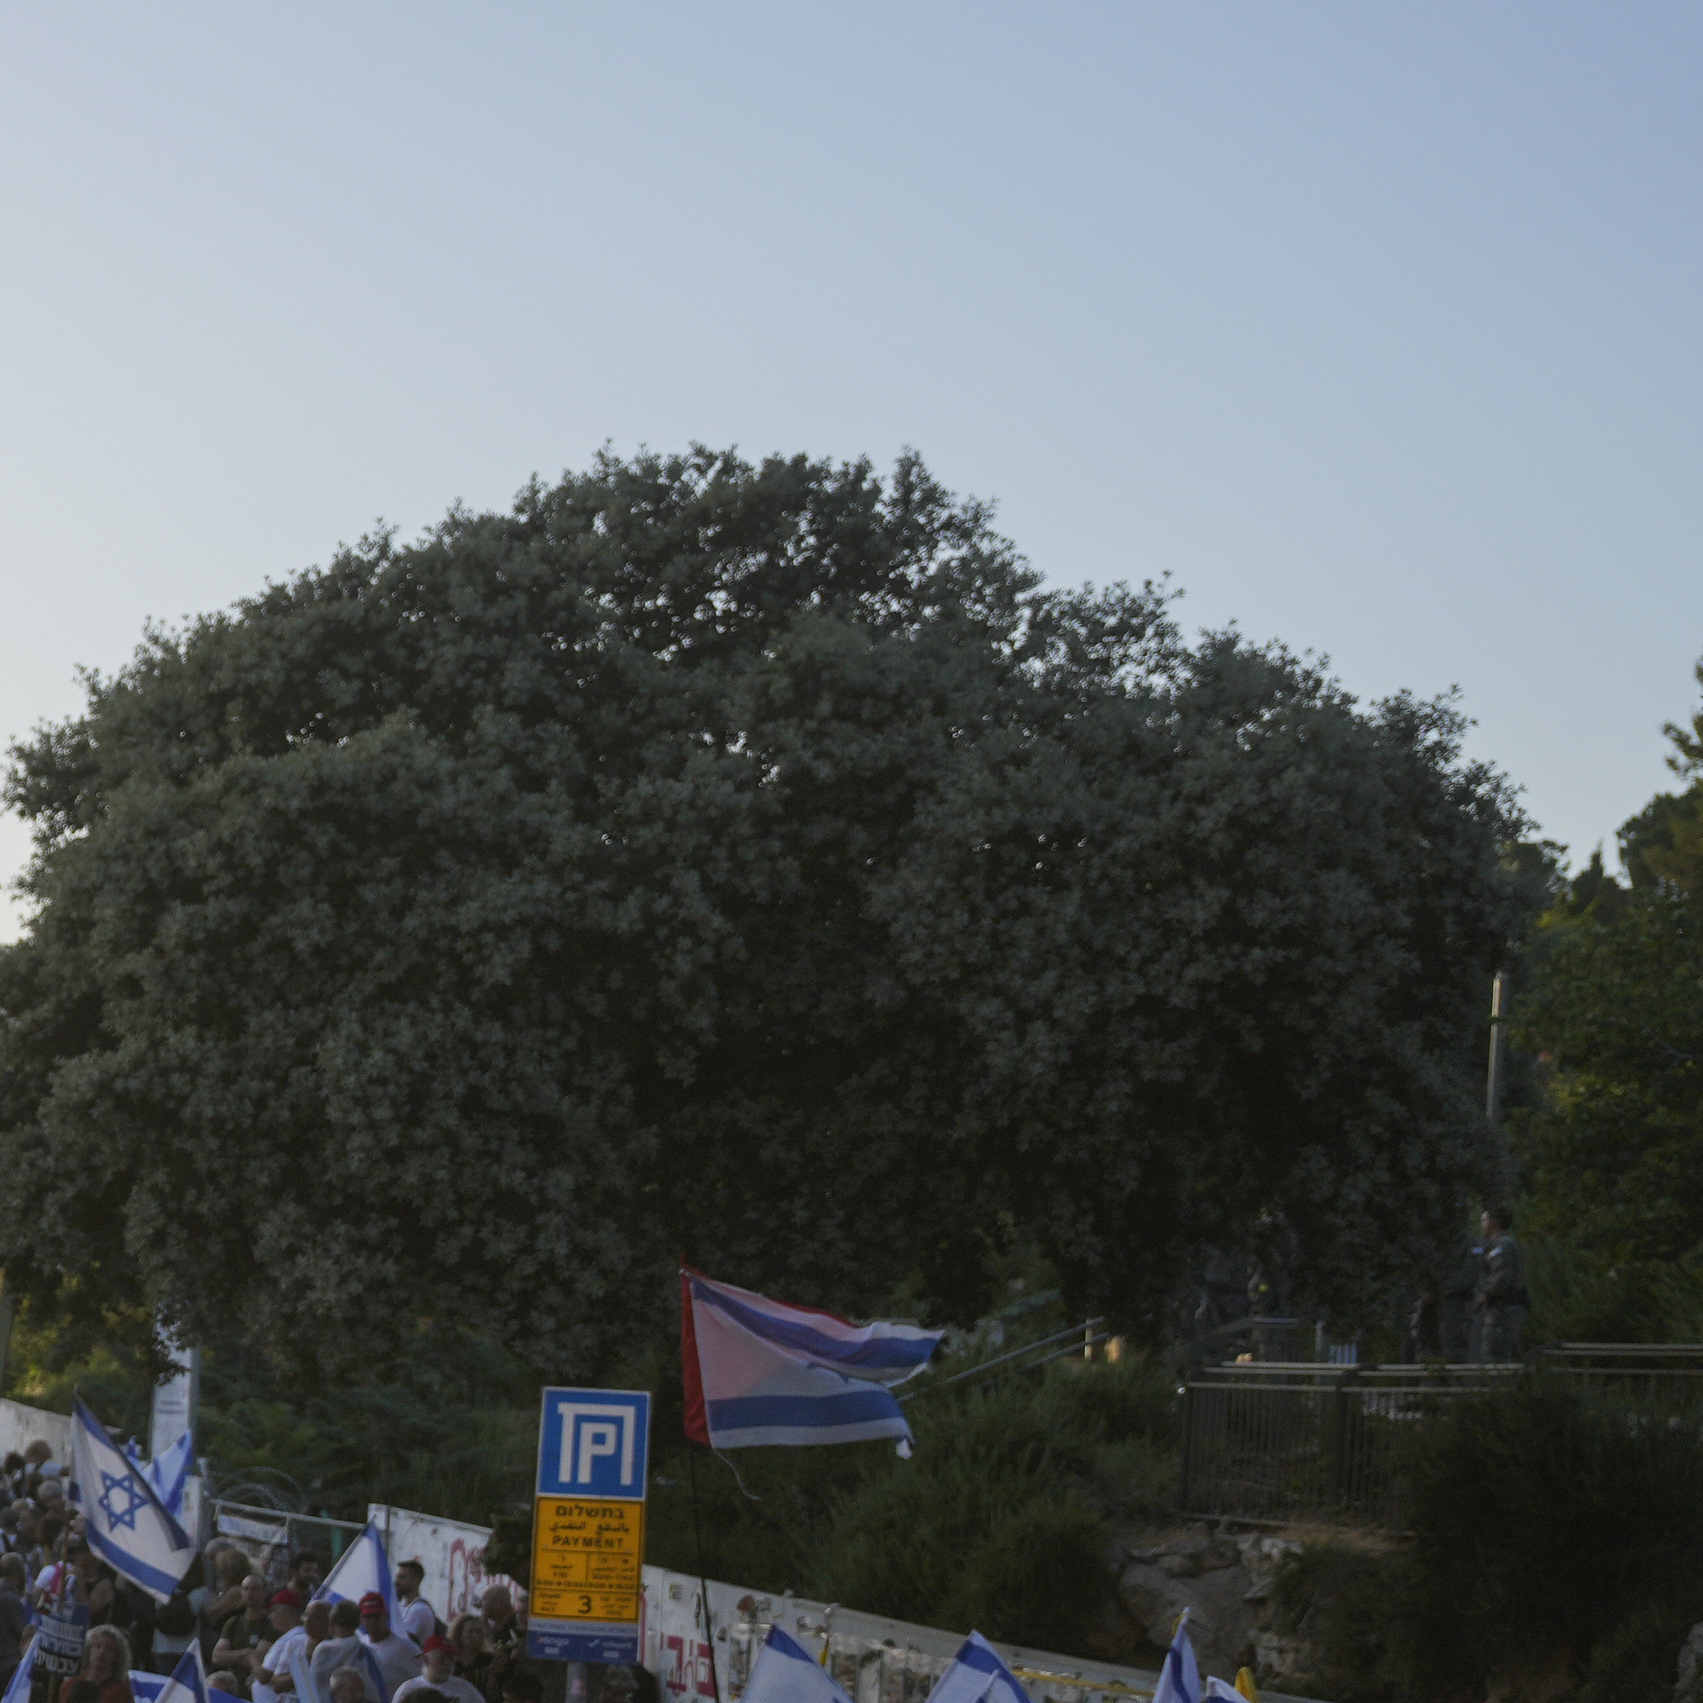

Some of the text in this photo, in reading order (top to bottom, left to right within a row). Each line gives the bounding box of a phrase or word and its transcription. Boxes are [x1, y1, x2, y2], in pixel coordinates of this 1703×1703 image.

[555, 1504, 627, 1520] בתשלום
[551, 1535, 624, 1549] PAYMENT
[578, 1594, 592, 1614] 3
